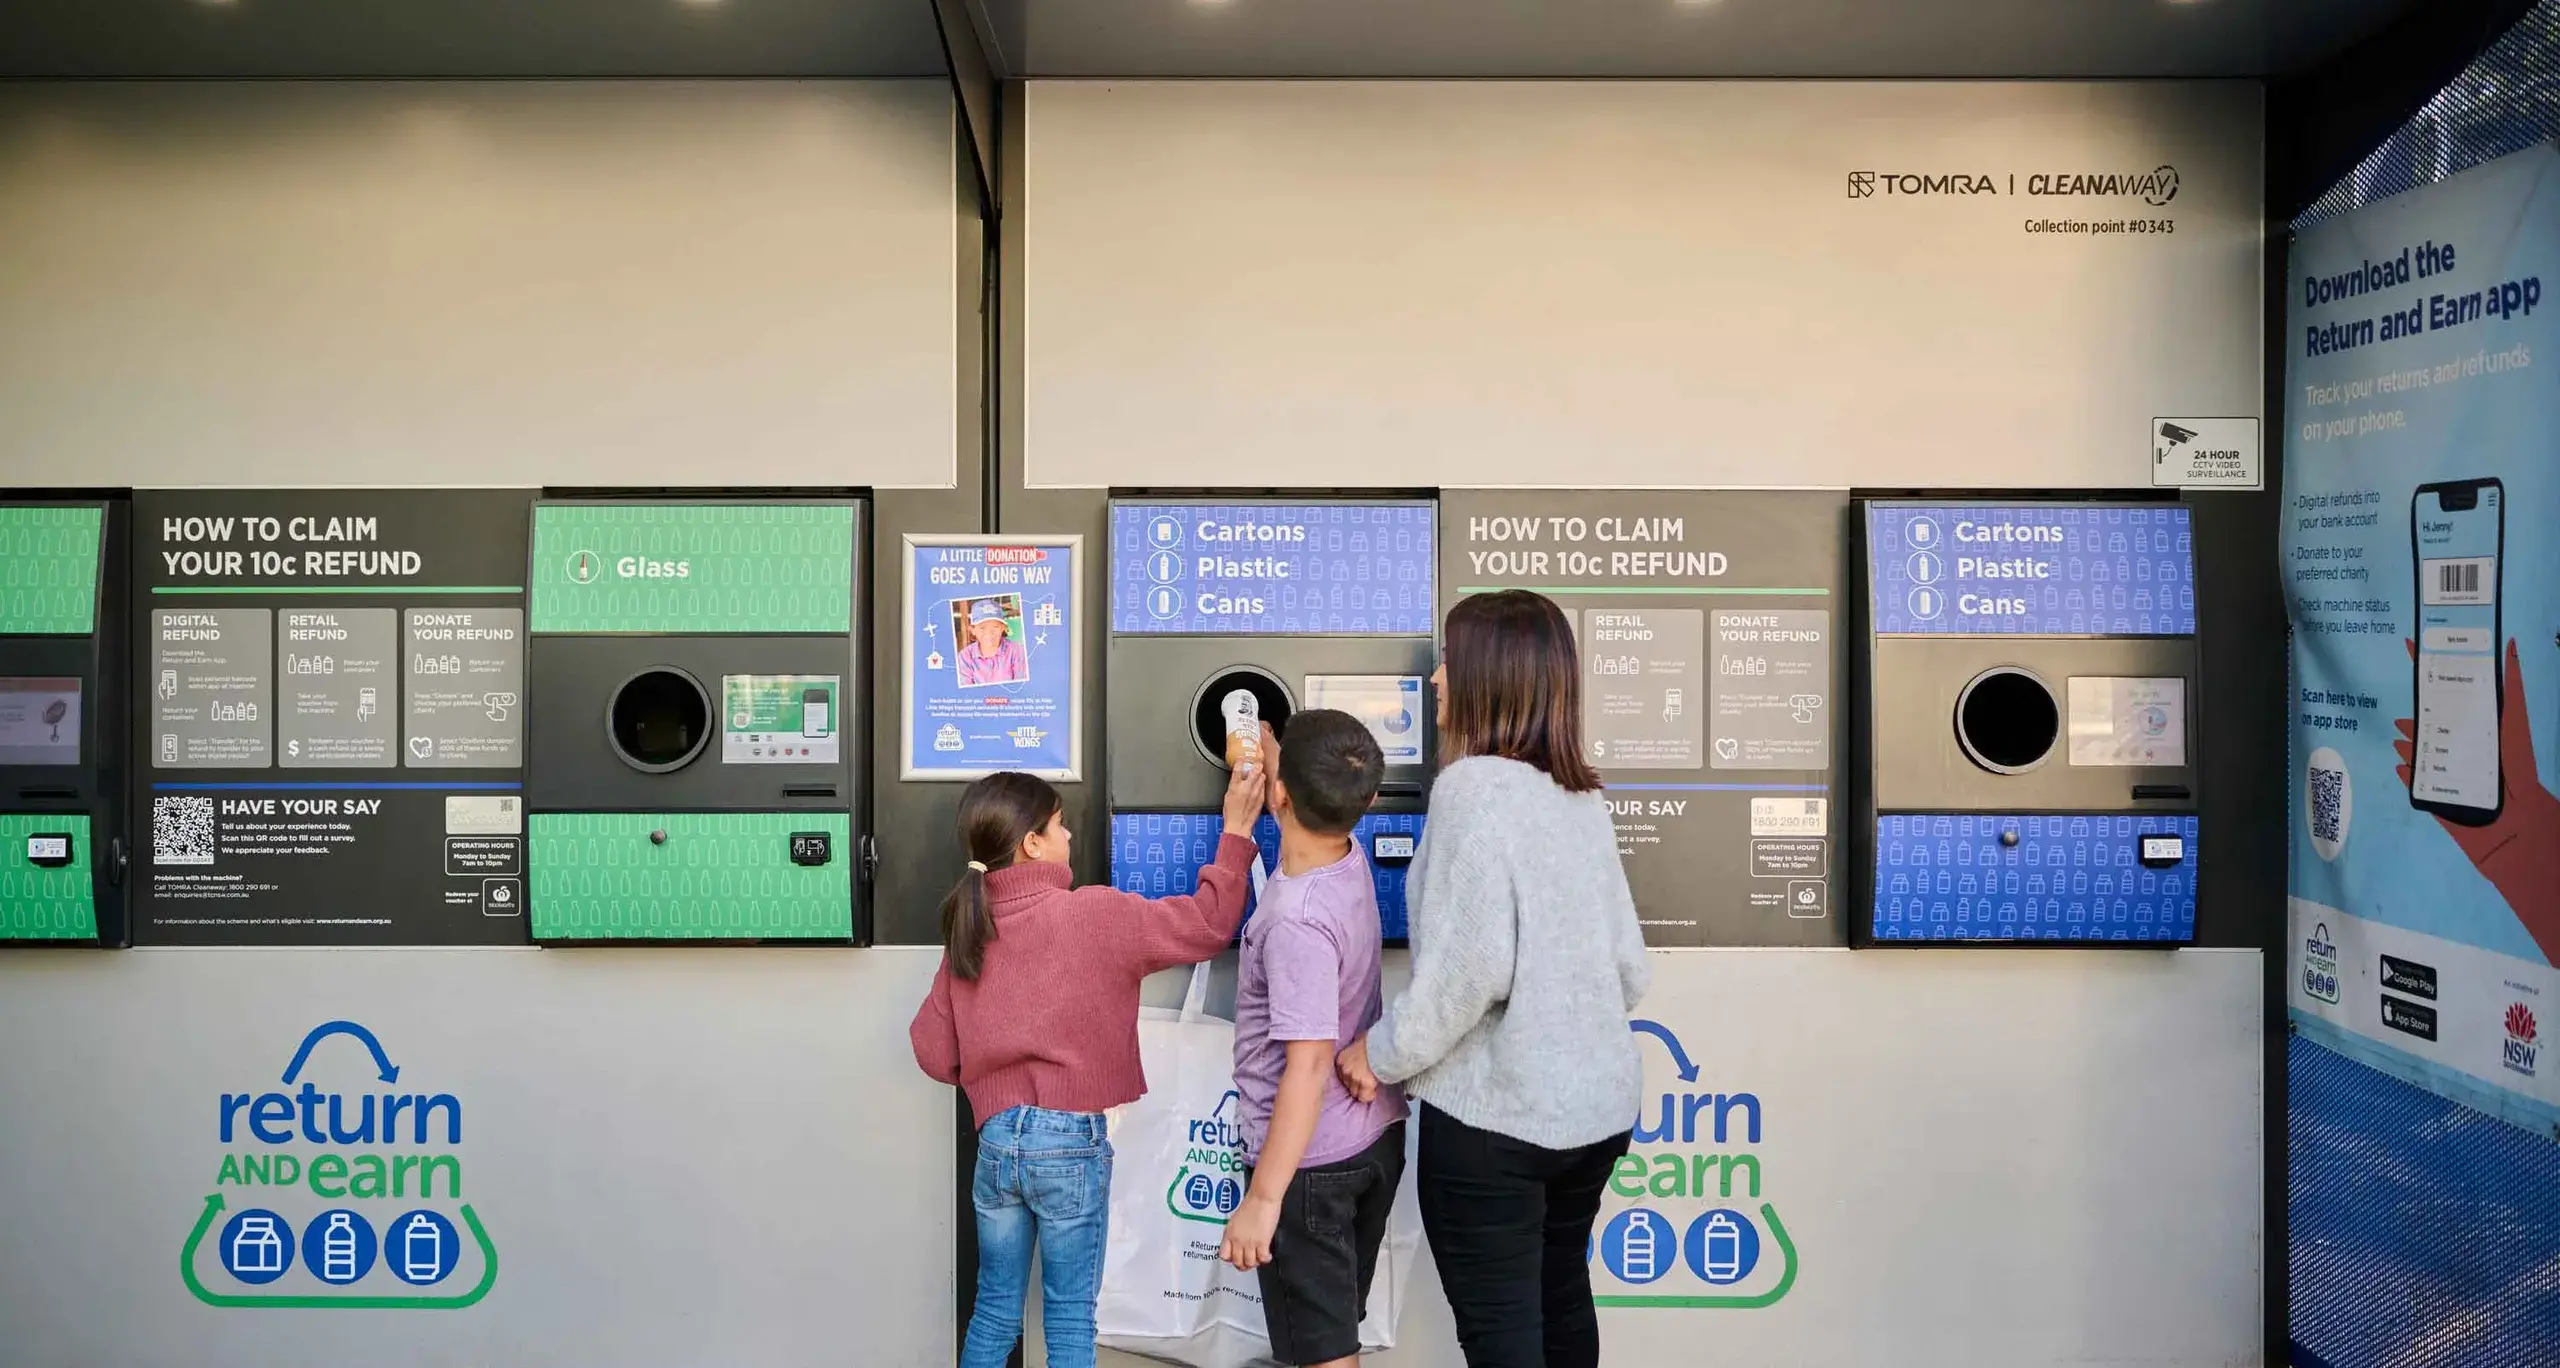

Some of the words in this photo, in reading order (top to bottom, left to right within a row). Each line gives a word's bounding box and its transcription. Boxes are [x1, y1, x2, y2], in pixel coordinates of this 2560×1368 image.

[1880, 174, 1997, 194] TOMRA
[2028, 174, 2172, 196] CLEANAWAY
[2025, 219, 2088, 233] Collection
[2092, 219, 2125, 236] point
[2129, 219, 2175, 234] #0343
[2306, 248, 2410, 307] Download
[2416, 240, 2455, 278] the
[2307, 318, 2374, 357] Return
[2381, 299, 2422, 342] and
[2430, 292, 2481, 330] Earn
[2486, 277, 2541, 320] app
[2305, 382, 2340, 407] Track
[2344, 380, 2372, 406] your
[2377, 367, 2429, 394] returns
[2434, 354, 2459, 383] and
[2463, 342, 2530, 377] refunds
[2303, 422, 2321, 441] on
[2326, 420, 2356, 442] your
[2360, 409, 2406, 436] phone.
[2194, 450, 2207, 459] 24
[2210, 450, 2240, 459] HOUR
[2193, 461, 2214, 469] CCTV
[2216, 461, 2241, 469] VIDEO
[2187, 470, 2246, 478] SURVEILLANCE
[2299, 494, 2328, 510] Digital
[2331, 491, 2362, 506] refunds
[2364, 490, 2380, 504] into
[164, 517, 235, 541] HOW
[242, 517, 280, 541] TO
[289, 517, 377, 541] CLAIM
[1470, 517, 1541, 541] HOW
[1548, 517, 1587, 541] TO
[1595, 518, 1683, 542] CLAIM
[2298, 517, 2318, 531] your
[2321, 514, 2343, 528] bank
[2345, 512, 2378, 527] account
[1198, 521, 1305, 542] Cartons
[1956, 522, 2064, 542] Cartons
[940, 551, 948, 562] A
[951, 549, 982, 562] LITTLE
[987, 549, 1036, 562] DONATION
[2297, 546, 2329, 559] Donate
[2332, 546, 2341, 558] to
[2343, 547, 2363, 561] your
[162, 551, 242, 575] YOUR
[250, 551, 296, 575] 10c
[305, 551, 421, 575] REFUND
[617, 556, 689, 578] Glass
[1199, 557, 1289, 578] Plastic
[1468, 551, 1548, 575] YOUR
[1557, 551, 1603, 575] 10c
[1612, 552, 1727, 576] REFUND
[1958, 558, 2050, 578] Plastic
[930, 567, 965, 584] GOES
[970, 567, 980, 584] A
[984, 567, 1017, 584] LONG
[1023, 567, 1052, 584] WAY
[2296, 566, 2338, 582] preferred
[2341, 566, 2369, 582] charity
[1198, 594, 1264, 614] Cans
[1959, 595, 2026, 615] Cans
[2324, 600, 2362, 612] machine
[2365, 599, 2390, 612] status
[163, 615, 218, 626] DIGITAL
[290, 615, 339, 626] RETAIL
[414, 614, 472, 626] DONATE
[1596, 615, 1645, 627] RETAIL
[1720, 616, 1778, 627] DONATE
[2326, 622, 2341, 634] you
[2344, 620, 2368, 633] leave
[2371, 620, 2395, 634] home
[163, 629, 220, 640] REFUND
[290, 629, 347, 640] REFUND
[414, 629, 452, 640] YOUR
[457, 629, 514, 640] REFUND
[1596, 630, 1653, 640] REFUND
[1720, 630, 1758, 641] YOUR
[1763, 631, 1820, 642] REFUND
[2302, 688, 2323, 703] Scan
[2327, 690, 2345, 706] here
[2346, 693, 2355, 708] to
[2358, 693, 2378, 708] view
[2302, 714, 2312, 725] on
[2314, 715, 2332, 730] app
[2335, 716, 2358, 730] store
[222, 800, 275, 815] HAVE
[281, 799, 337, 815] YOUR
[343, 799, 381, 815] SAY
[1649, 800, 1687, 816] SAY
[287, 823, 328, 831] experience
[329, 823, 351, 831] today.
[1635, 824, 1657, 832] today.
[235, 847, 274, 855] appreciate
[294, 846, 330, 854] feedback.
[2307, 938, 2336, 961] return
[2394, 972, 2418, 989] Google
[2420, 980, 2435, 994] Play
[2396, 1013, 2409, 1027] App
[2410, 1017, 2430, 1032] Store
[2504, 1038, 2536, 1069] NSW
[220, 1082, 461, 1144] return
[1189, 1116, 1241, 1147] retu
[1185, 1148, 1217, 1165] AND
[217, 1154, 300, 1186] AND
[308, 1154, 460, 1199] earn
[1608, 1153, 1760, 1197] earn
[1164, 1290, 1184, 1299] Made
[1222, 1286, 1254, 1301] recycled
